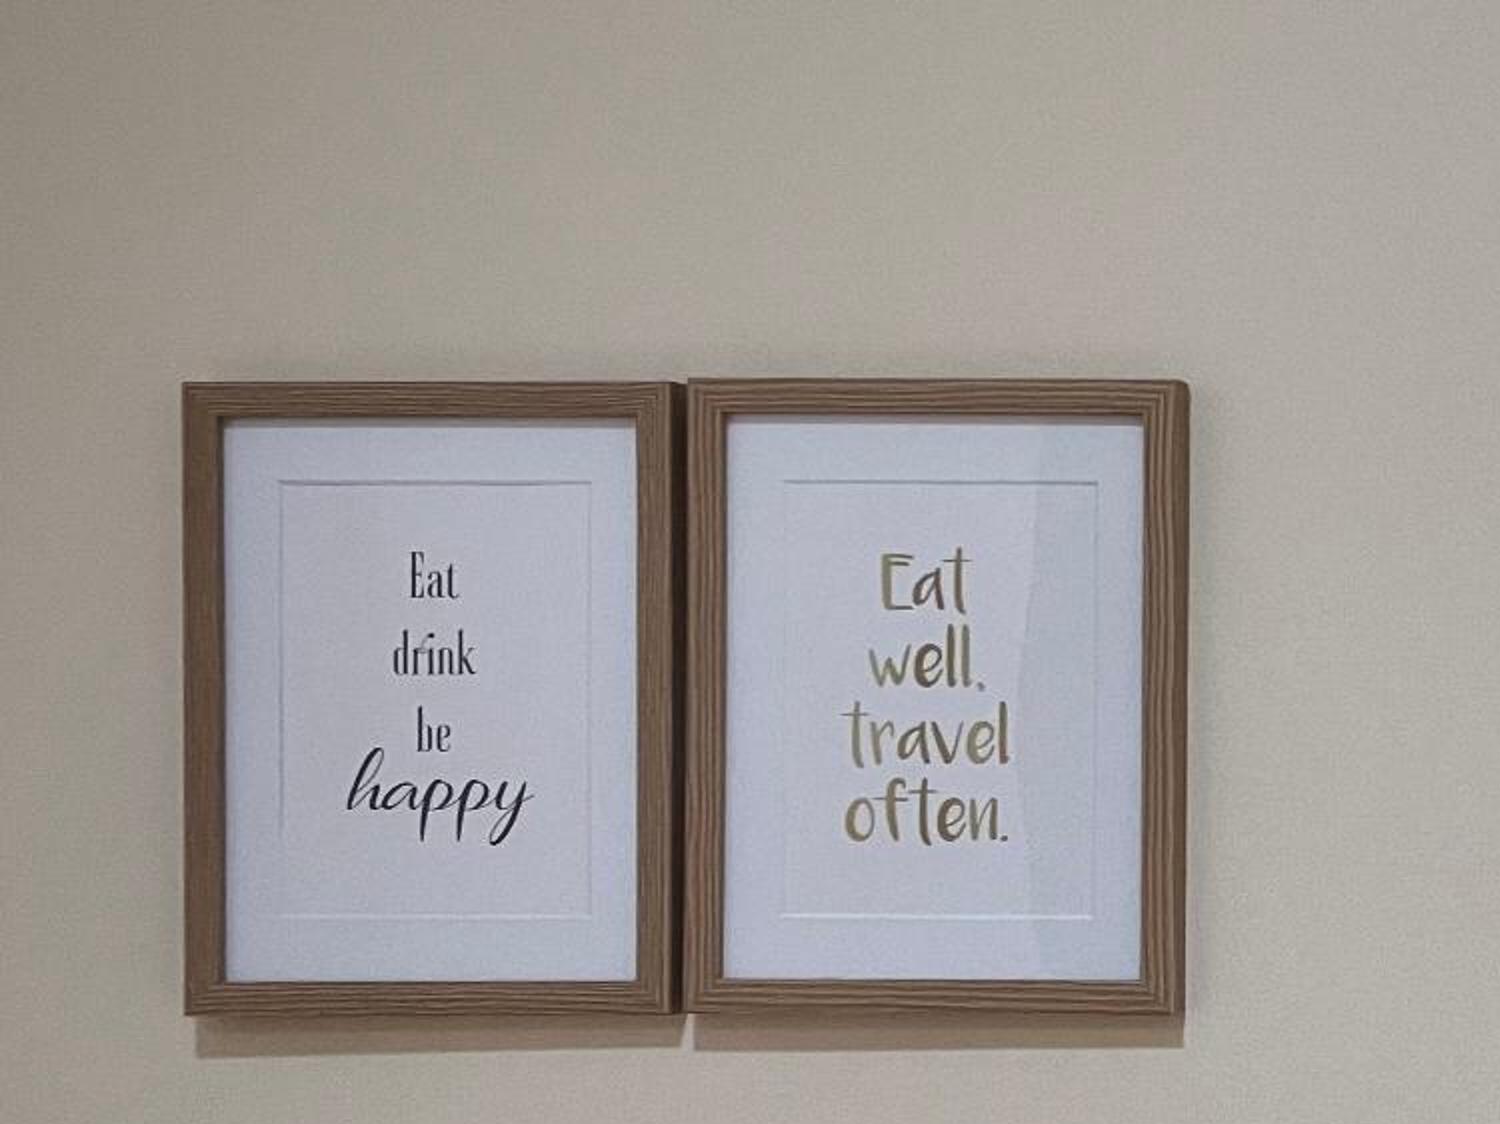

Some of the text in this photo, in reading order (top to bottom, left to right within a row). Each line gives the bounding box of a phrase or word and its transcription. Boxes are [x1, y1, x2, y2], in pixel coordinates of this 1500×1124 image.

[409, 550, 460, 600] Eat
[881, 546, 972, 615] Eat
[392, 627, 477, 677] drink
[416, 704, 452, 753] be
[841, 700, 1010, 769] travel
[345, 747, 535, 847] happy
[844, 777, 1009, 847] often.
